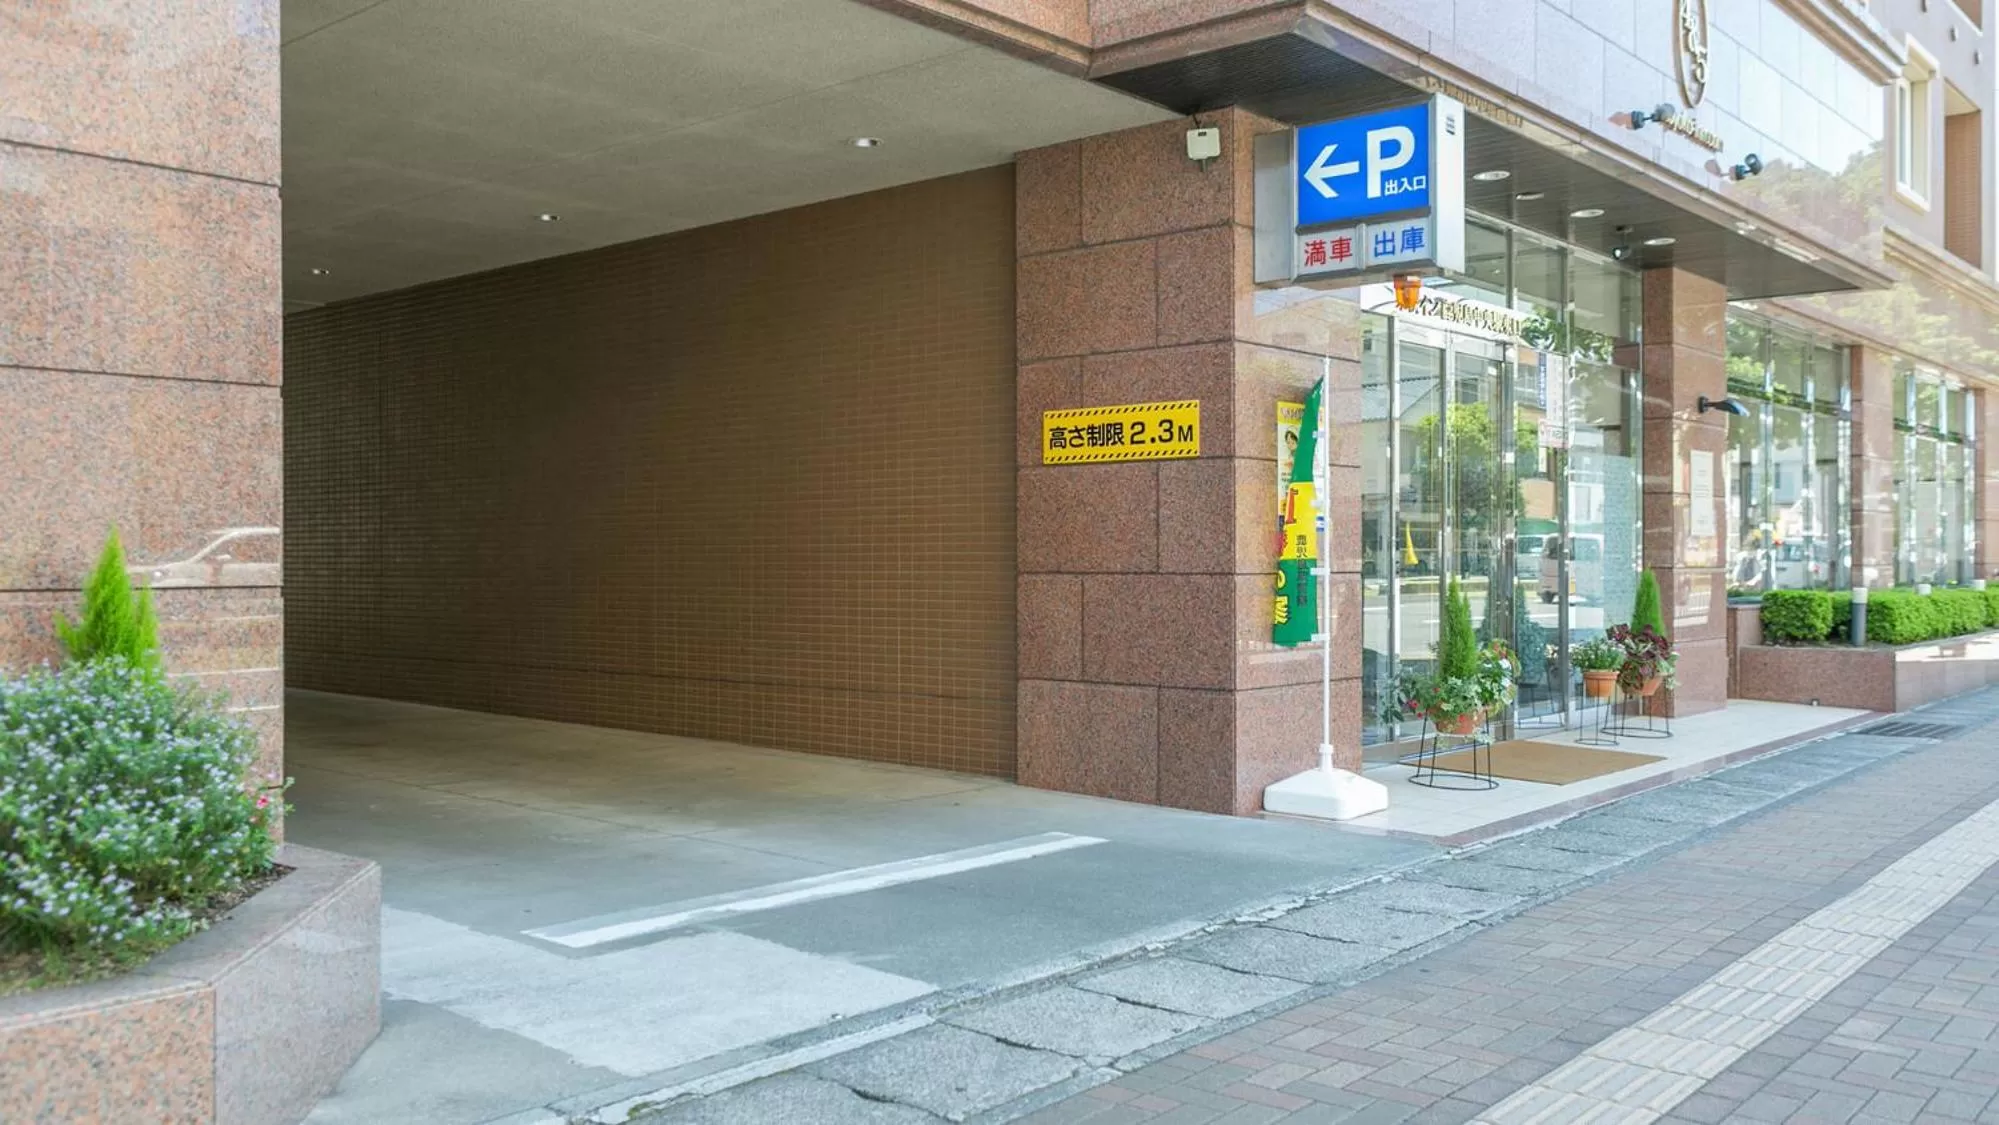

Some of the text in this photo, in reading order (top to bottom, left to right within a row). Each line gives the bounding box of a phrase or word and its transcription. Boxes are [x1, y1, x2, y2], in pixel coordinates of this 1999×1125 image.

[1366, 125, 1415, 199] P
[1384, 176, 1427, 195] 出入口
[1303, 236, 1353, 267] 満車
[1374, 226, 1425, 257] 出庫
[1049, 422, 1125, 450] 高さ制限
